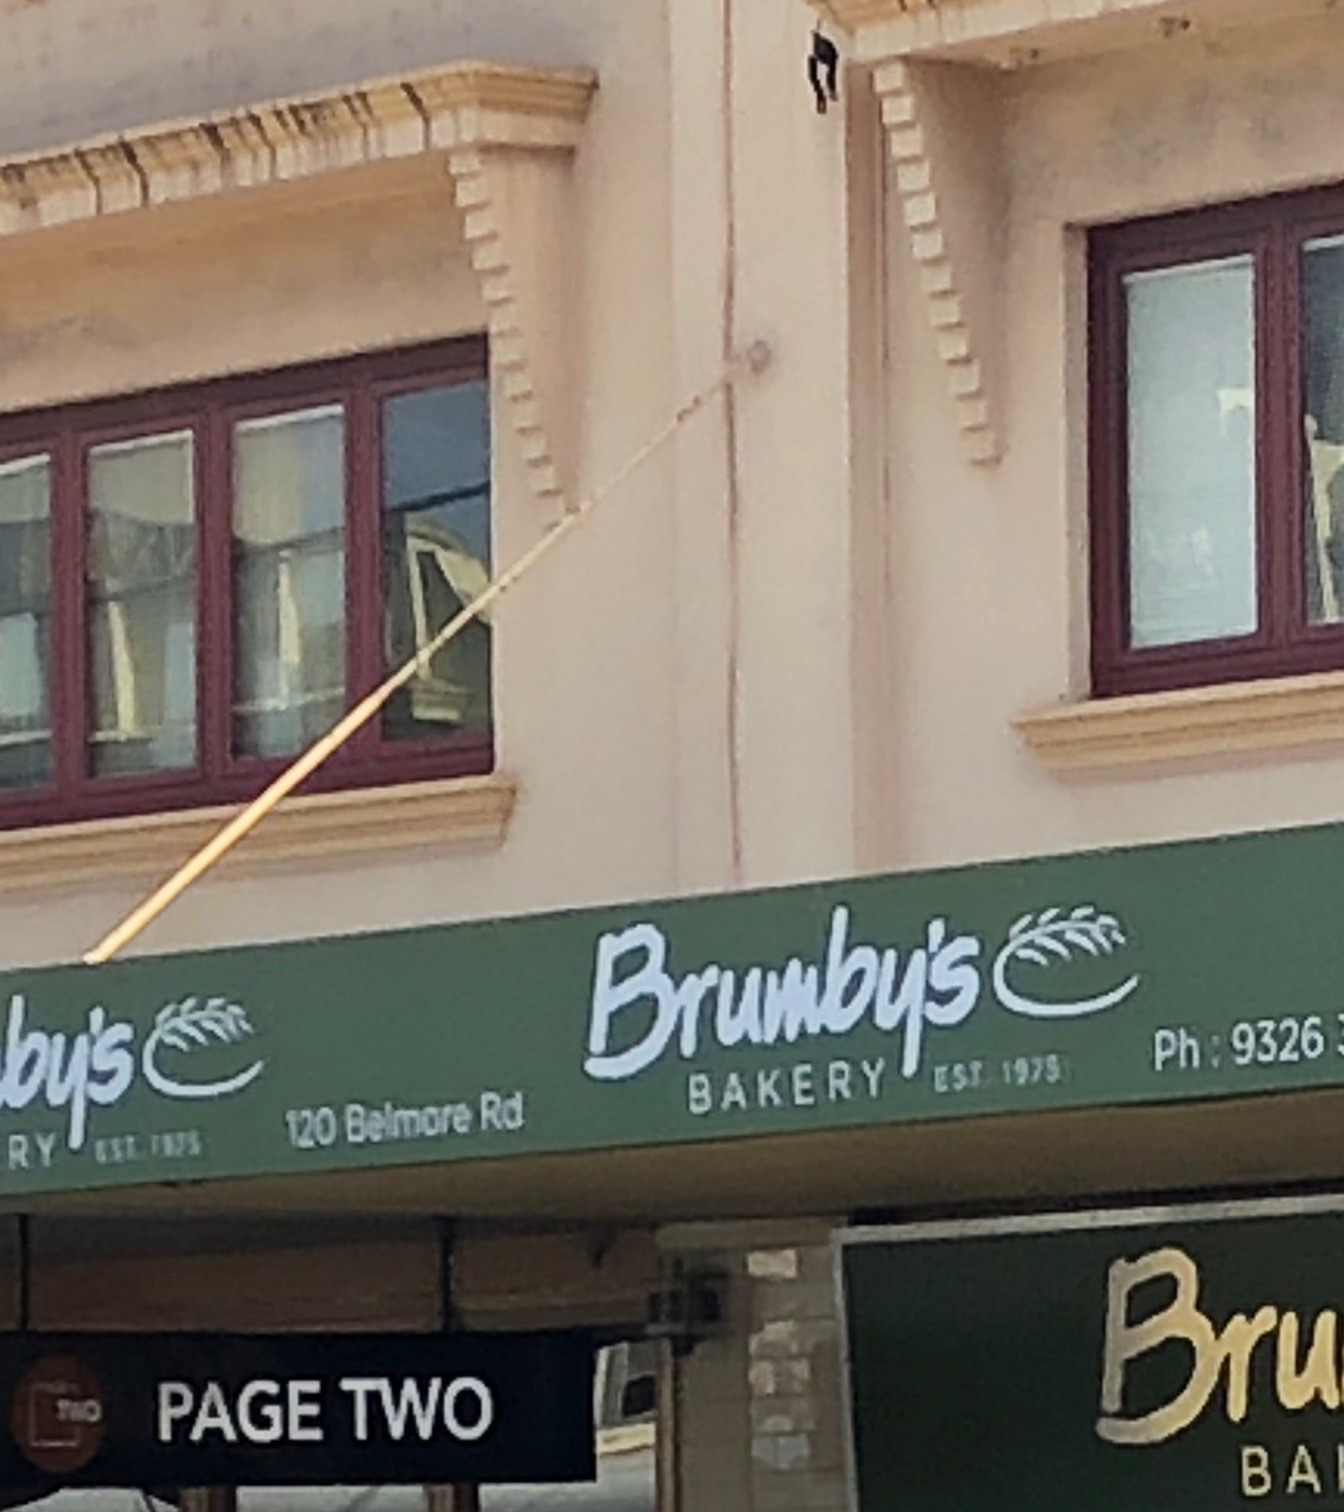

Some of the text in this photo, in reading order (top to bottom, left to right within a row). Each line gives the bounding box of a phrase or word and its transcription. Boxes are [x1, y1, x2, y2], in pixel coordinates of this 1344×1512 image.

[582, 904, 981, 1079] Brumby's
[1231, 1015, 1325, 1066] 9326
[686, 1056, 886, 1114] BAKERY
[285, 1091, 524, 1149] 120 Belmore Rd
[159, 1376, 493, 1443] PAGE TWO
